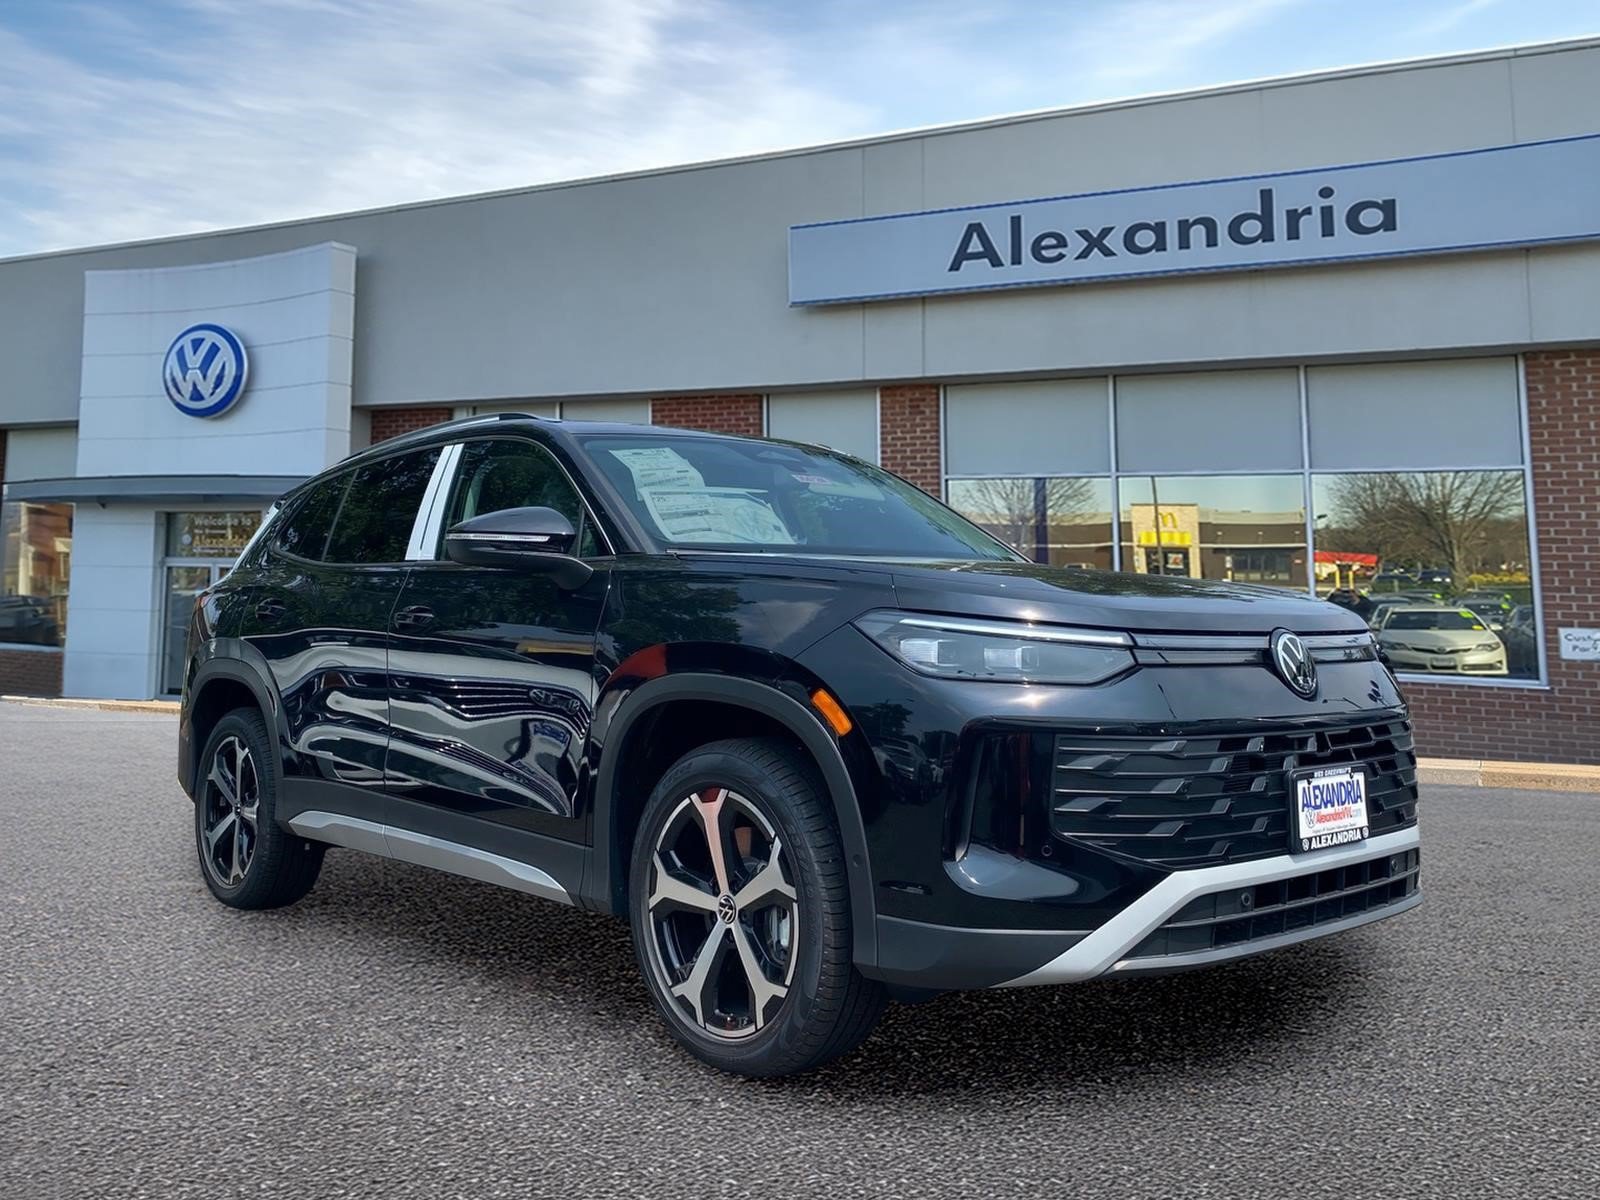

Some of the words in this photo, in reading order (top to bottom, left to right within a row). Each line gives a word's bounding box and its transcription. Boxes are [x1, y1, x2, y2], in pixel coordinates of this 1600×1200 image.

[947, 186, 1398, 272] Alexandria
[194, 516, 237, 526] Welcome
[1302, 779, 1363, 812] ALEXANDRIA
[1311, 829, 1361, 849] ALEXANDRIA
